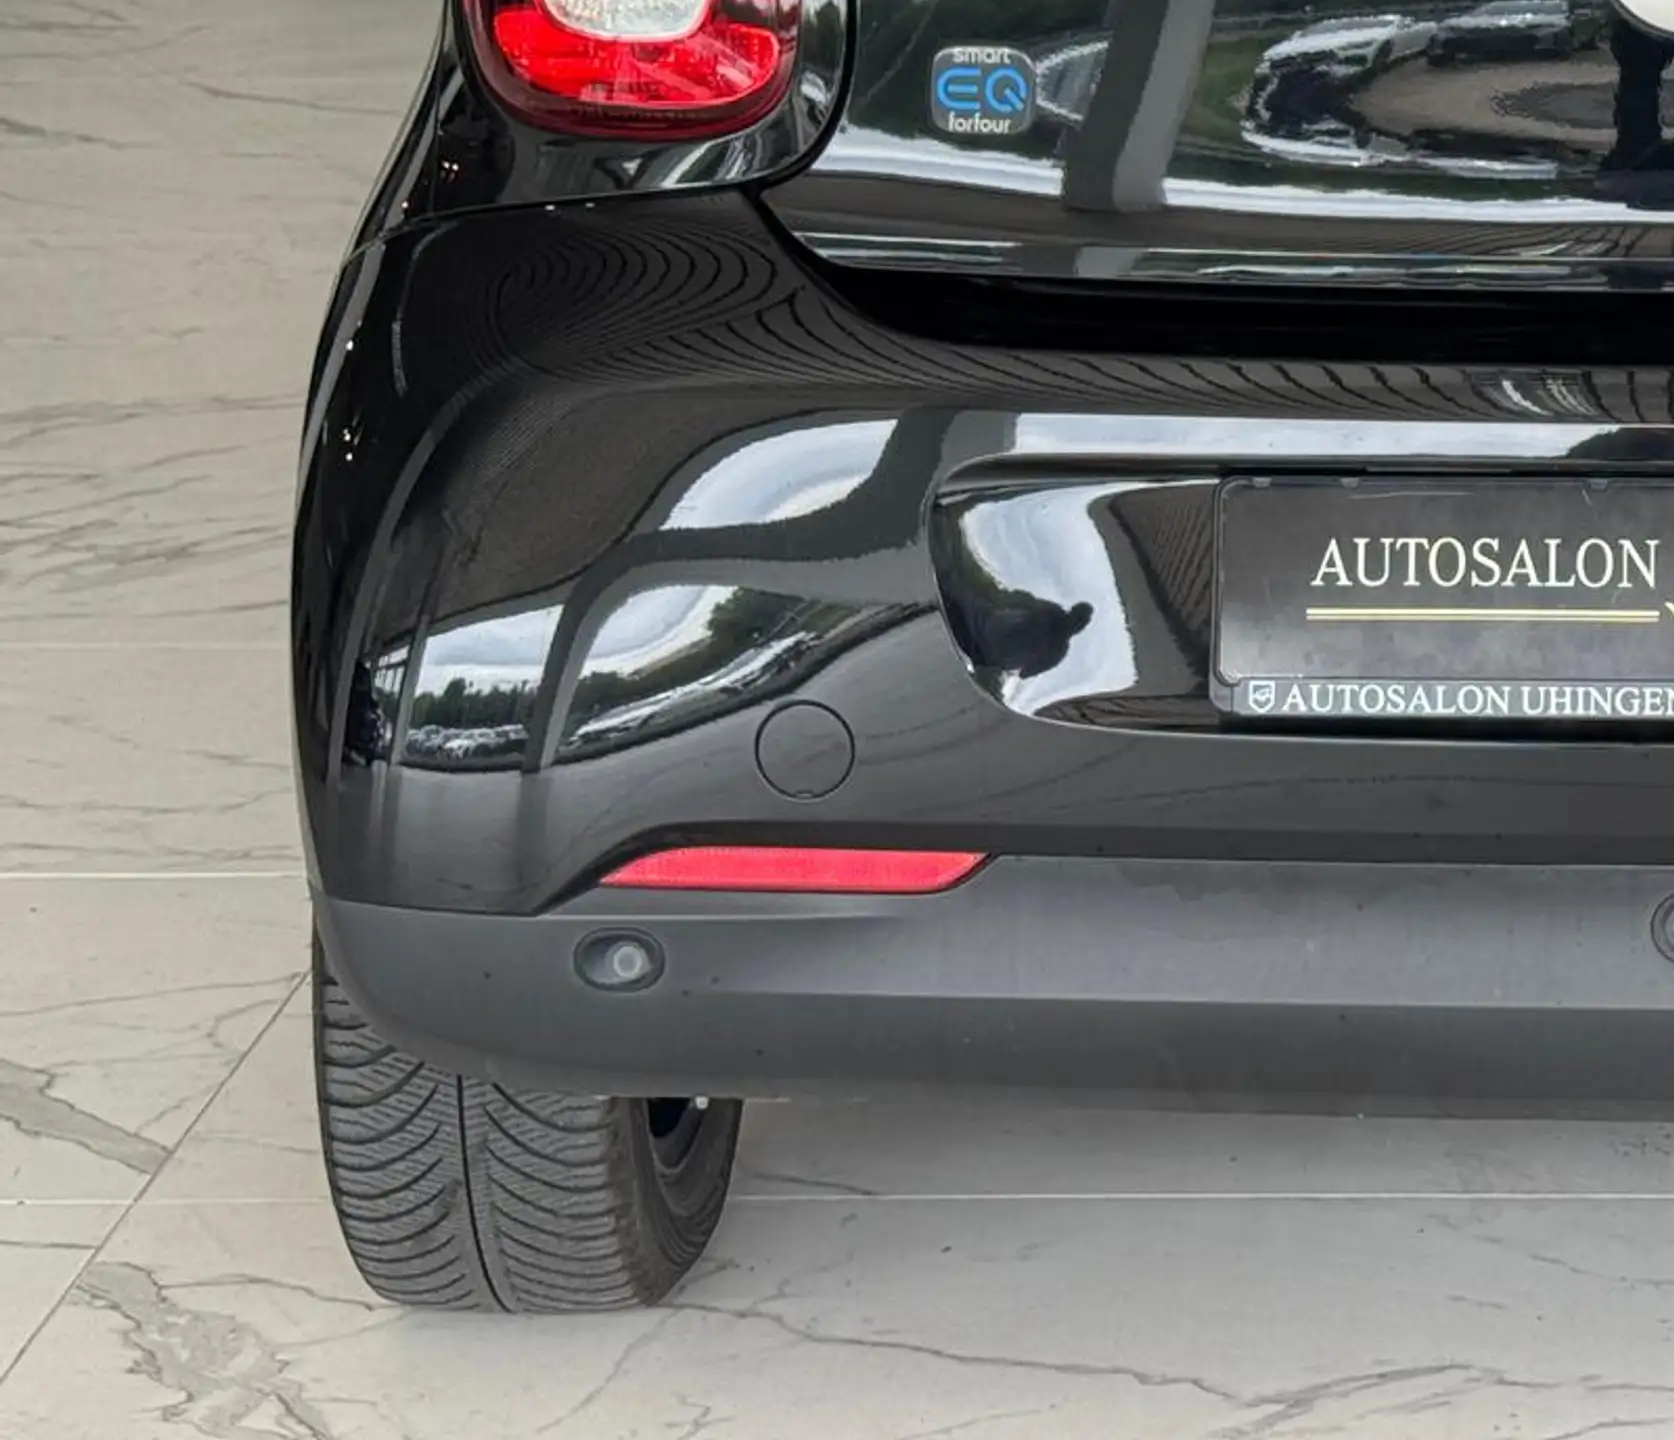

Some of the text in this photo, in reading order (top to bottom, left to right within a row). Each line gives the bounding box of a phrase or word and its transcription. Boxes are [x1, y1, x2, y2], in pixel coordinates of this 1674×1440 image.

[952, 48, 1012, 64] smart
[936, 67, 1028, 112] EQ
[948, 111, 1013, 134] forfour
[1310, 537, 1661, 589] AUTOSALON
[1281, 684, 1510, 715] AUTOSALON
